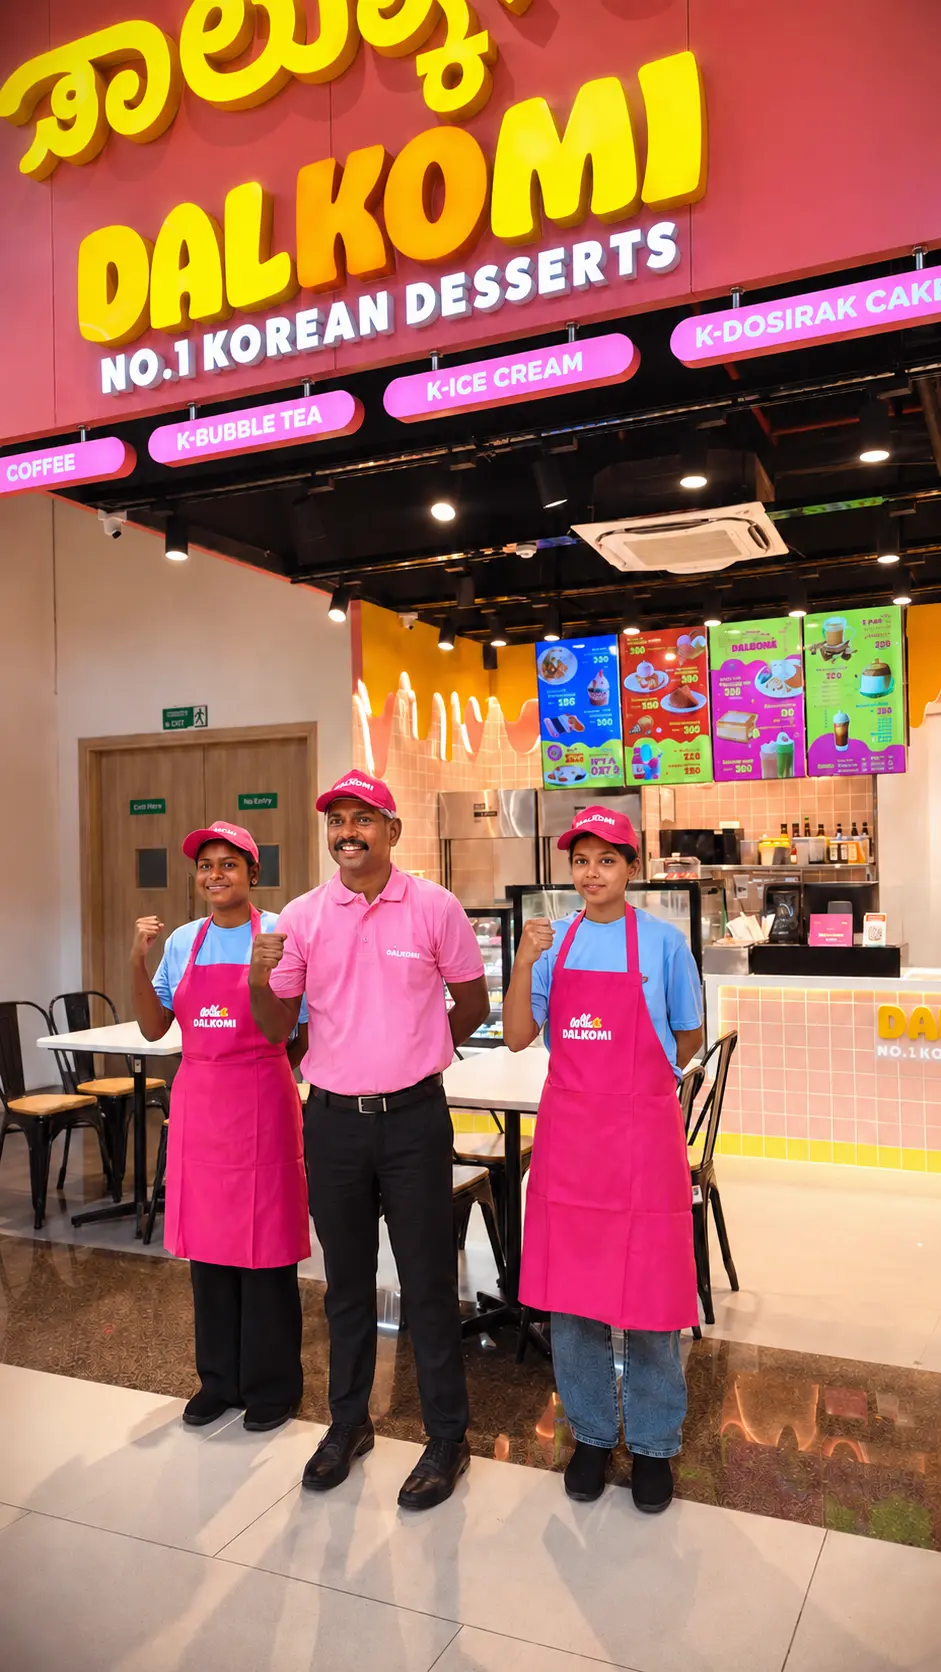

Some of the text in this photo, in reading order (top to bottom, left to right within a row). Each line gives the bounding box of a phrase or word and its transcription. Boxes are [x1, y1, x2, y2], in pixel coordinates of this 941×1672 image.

[78, 51, 706, 345] DALKOMI
[99, 221, 679, 396] NO.1 KOREAN DESSERTS
[695, 295, 857, 348] K-DOSIRAK
[427, 351, 583, 401] K-ICE CREAM
[177, 405, 323, 451] K-BUBBLE TEA
[6, 453, 76, 482] COFFEE
[562, 1028, 612, 1040] DALKOMI
[877, 1004, 941, 1041] DA
[877, 1045, 916, 1059] NO.1
